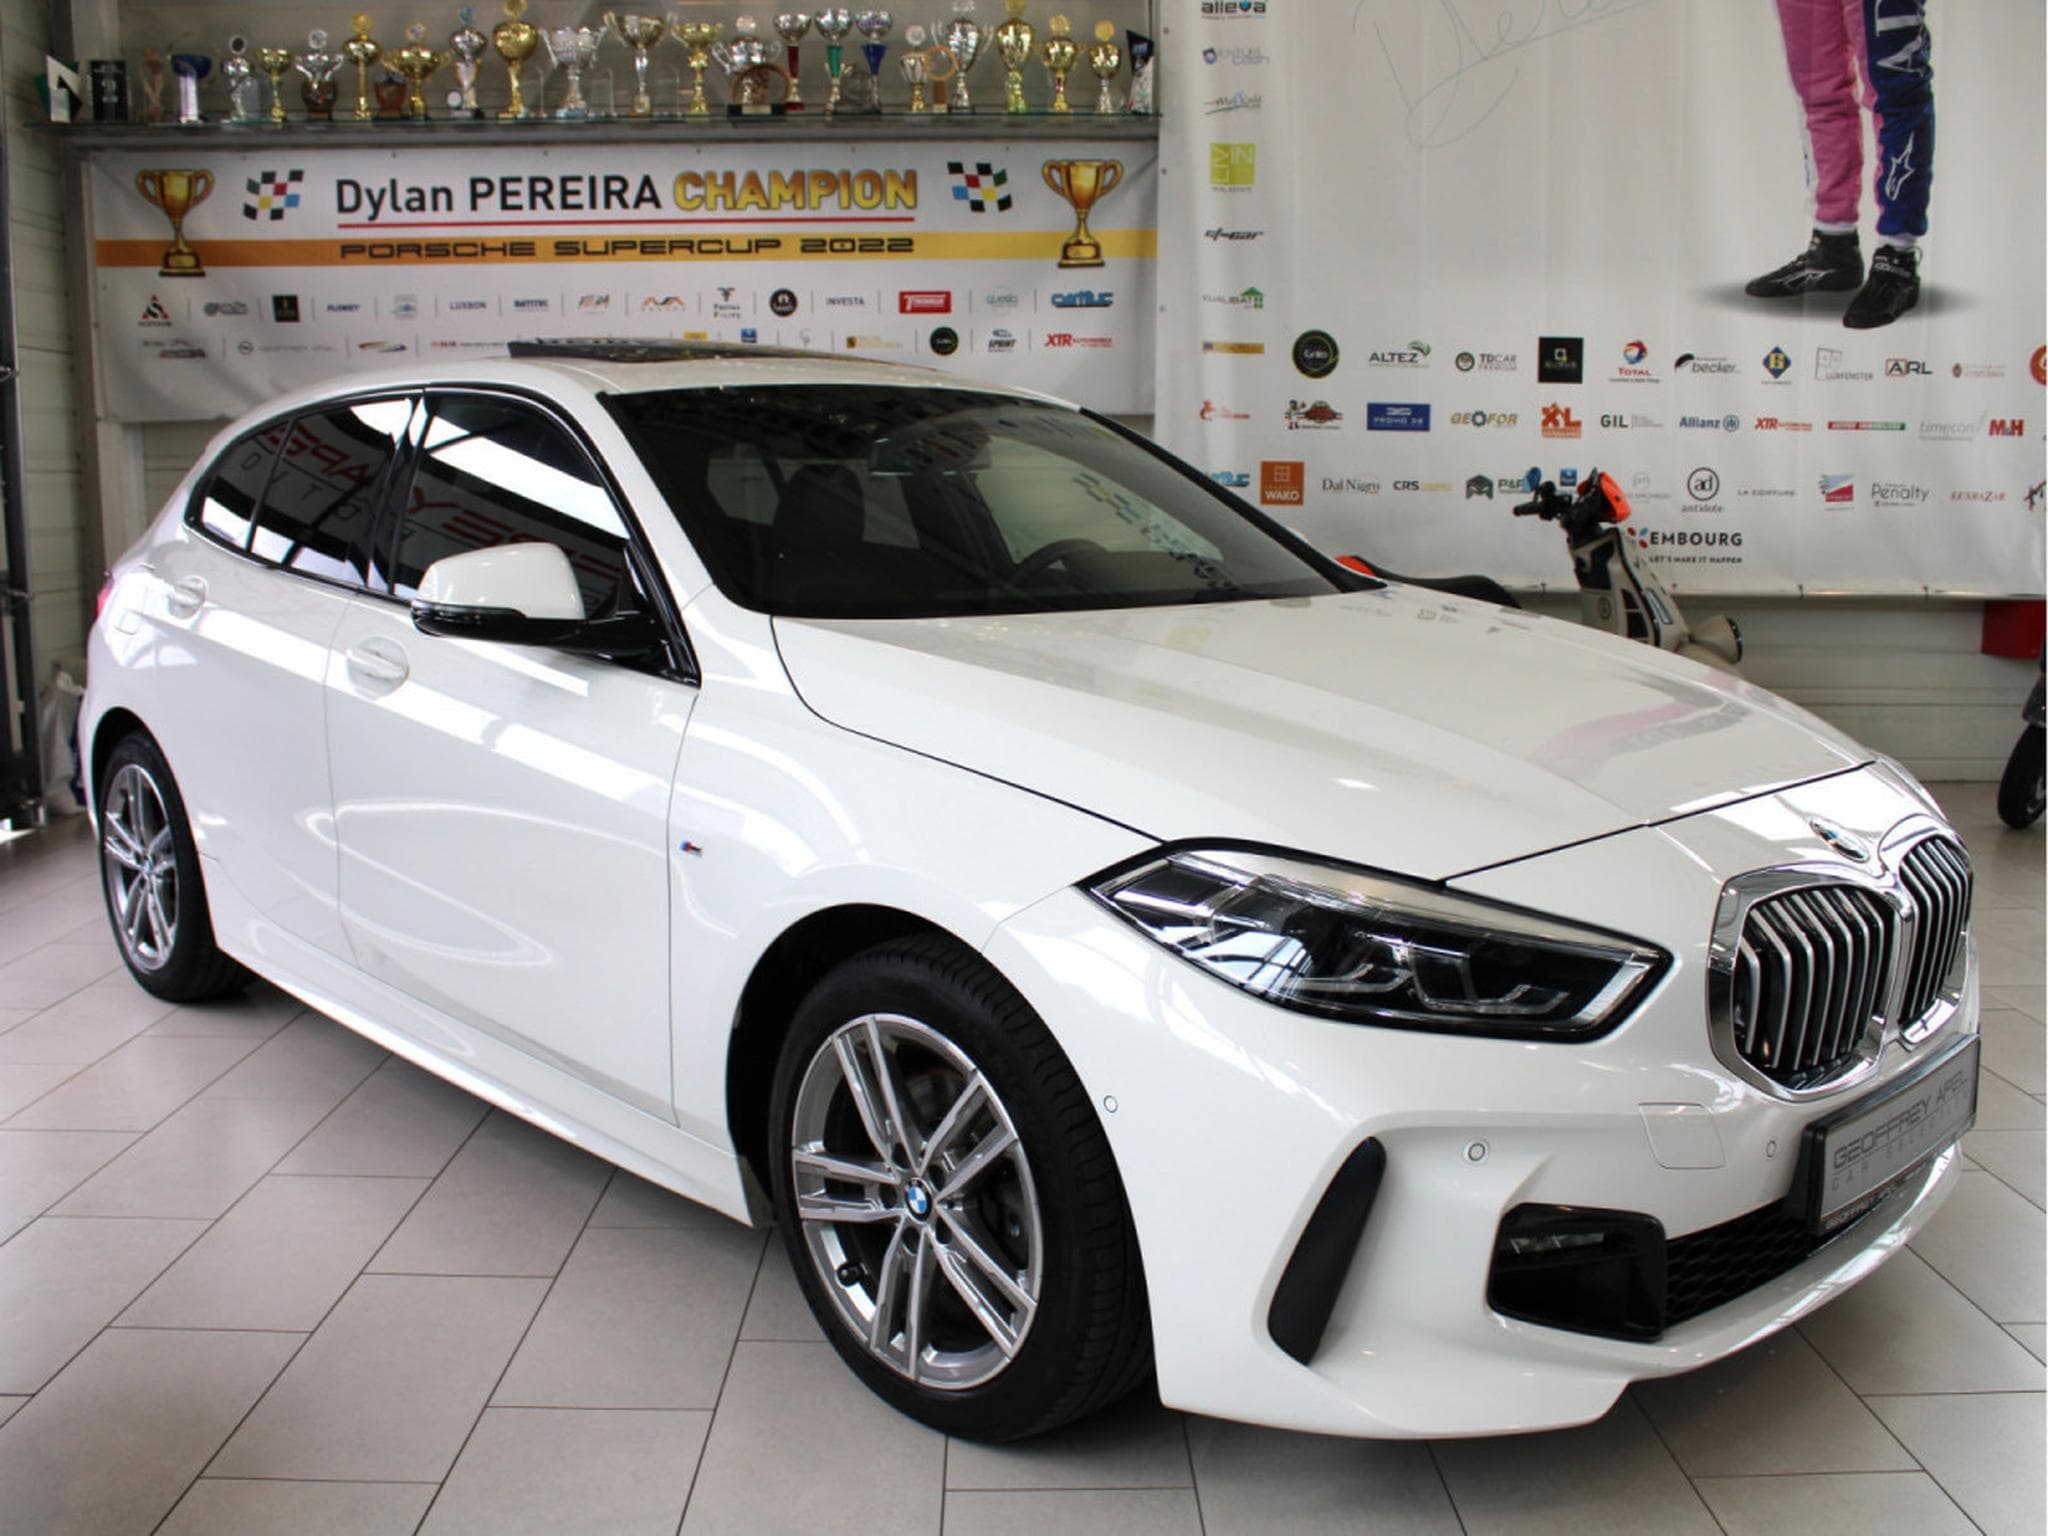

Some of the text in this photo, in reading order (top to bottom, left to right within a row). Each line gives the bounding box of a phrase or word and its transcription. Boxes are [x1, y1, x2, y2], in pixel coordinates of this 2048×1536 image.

[336, 168, 918, 221] Dylan PEREIRA CHAMPION
[340, 237, 914, 259] PORSCHE SUPERCUP 2022
[1369, 352, 1419, 363] ALTEZ
[1618, 367, 1652, 376] TOTAL
[1887, 361, 1933, 375] ARL
[1451, 410, 1518, 428] GEOFOR
[1541, 402, 1582, 428] XL
[1600, 414, 1628, 428] GIL
[1679, 416, 1721, 429] Allianz
[1322, 478, 1344, 491] Dal
[1393, 480, 1420, 491] CRS
[1693, 475, 1714, 492] ad
[1264, 490, 1299, 501] WAKO
[1871, 482, 1930, 502] Penalty
[1833, 1094, 1932, 1171] GEOFFREY
